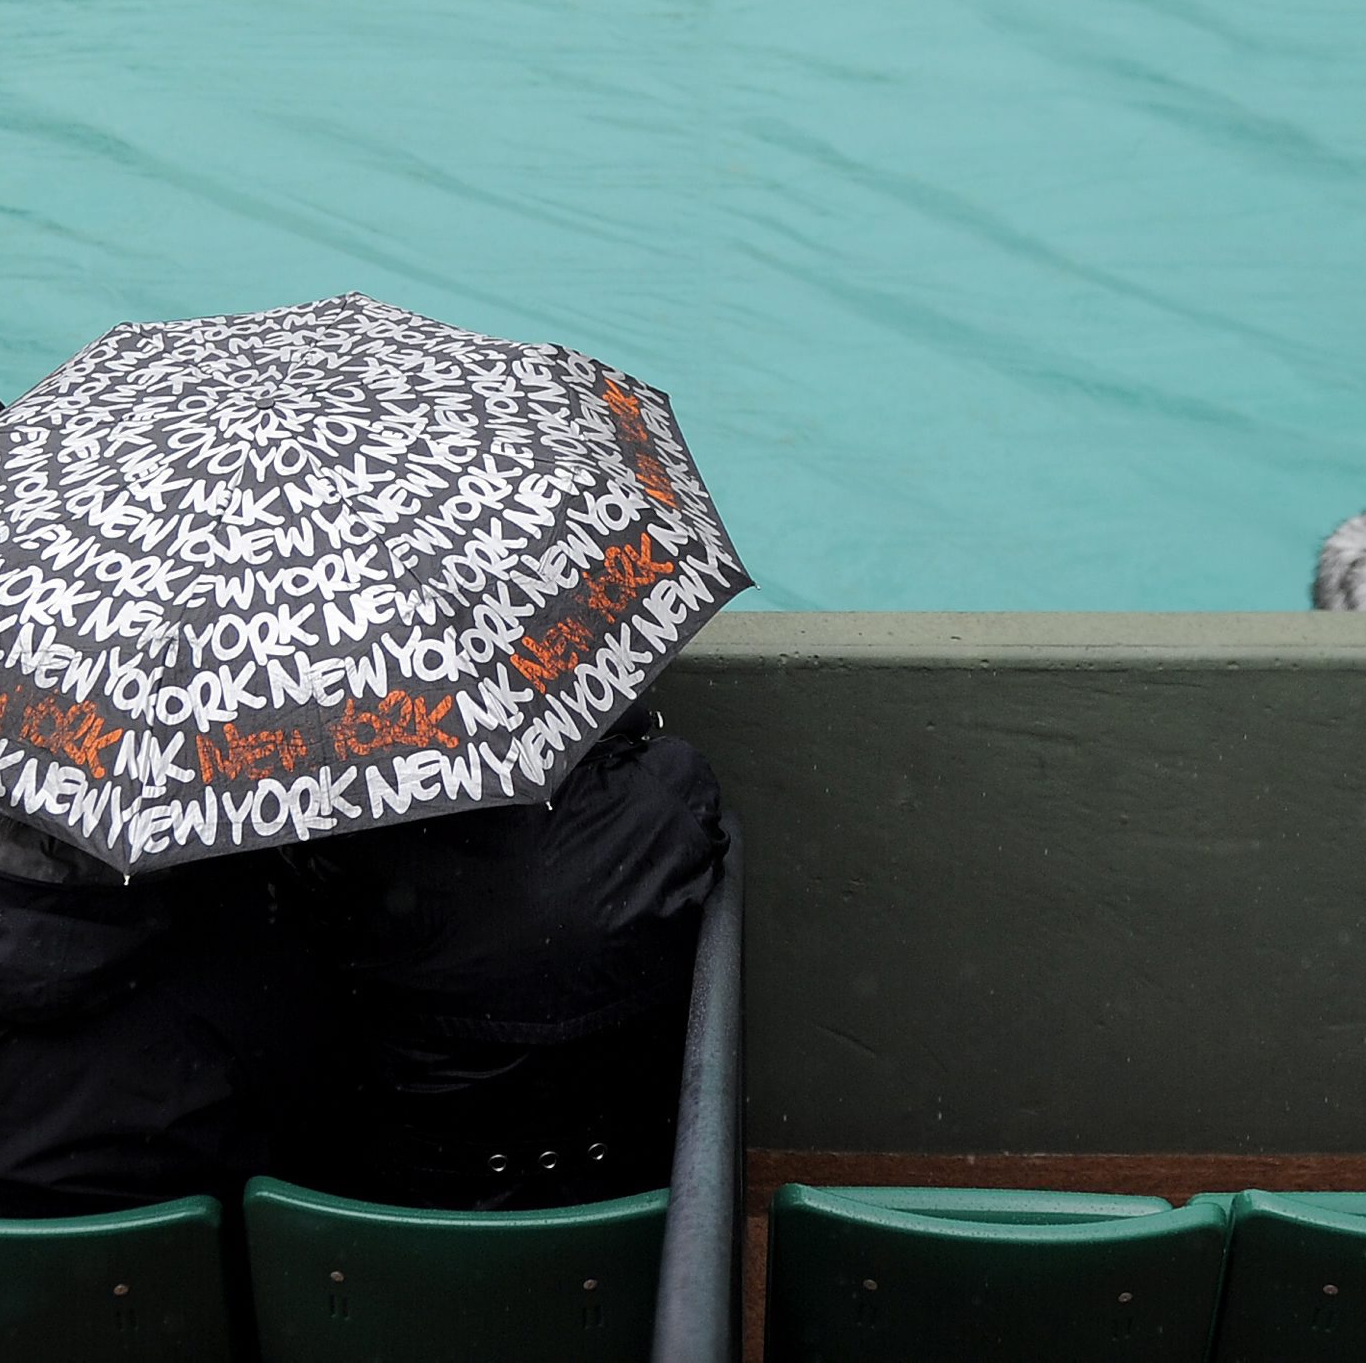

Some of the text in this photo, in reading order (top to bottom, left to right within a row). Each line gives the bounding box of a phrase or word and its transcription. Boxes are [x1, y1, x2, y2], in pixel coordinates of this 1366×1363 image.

[73, 542, 193, 600] YORK
[256, 543, 388, 600] YORK
[510, 520, 604, 608] NEW
[5, 622, 107, 703] NEW
[78, 597, 180, 668] NEW
[185, 583, 436, 668] YORK NEW
[560, 622, 653, 729] YORK
[631, 561, 715, 654] NEW
[266, 643, 387, 709] NEW
[196, 690, 459, 784] NEW YORK
[10, 758, 113, 838] NEW
[222, 765, 363, 842] YORK
[365, 742, 482, 820] NEW
